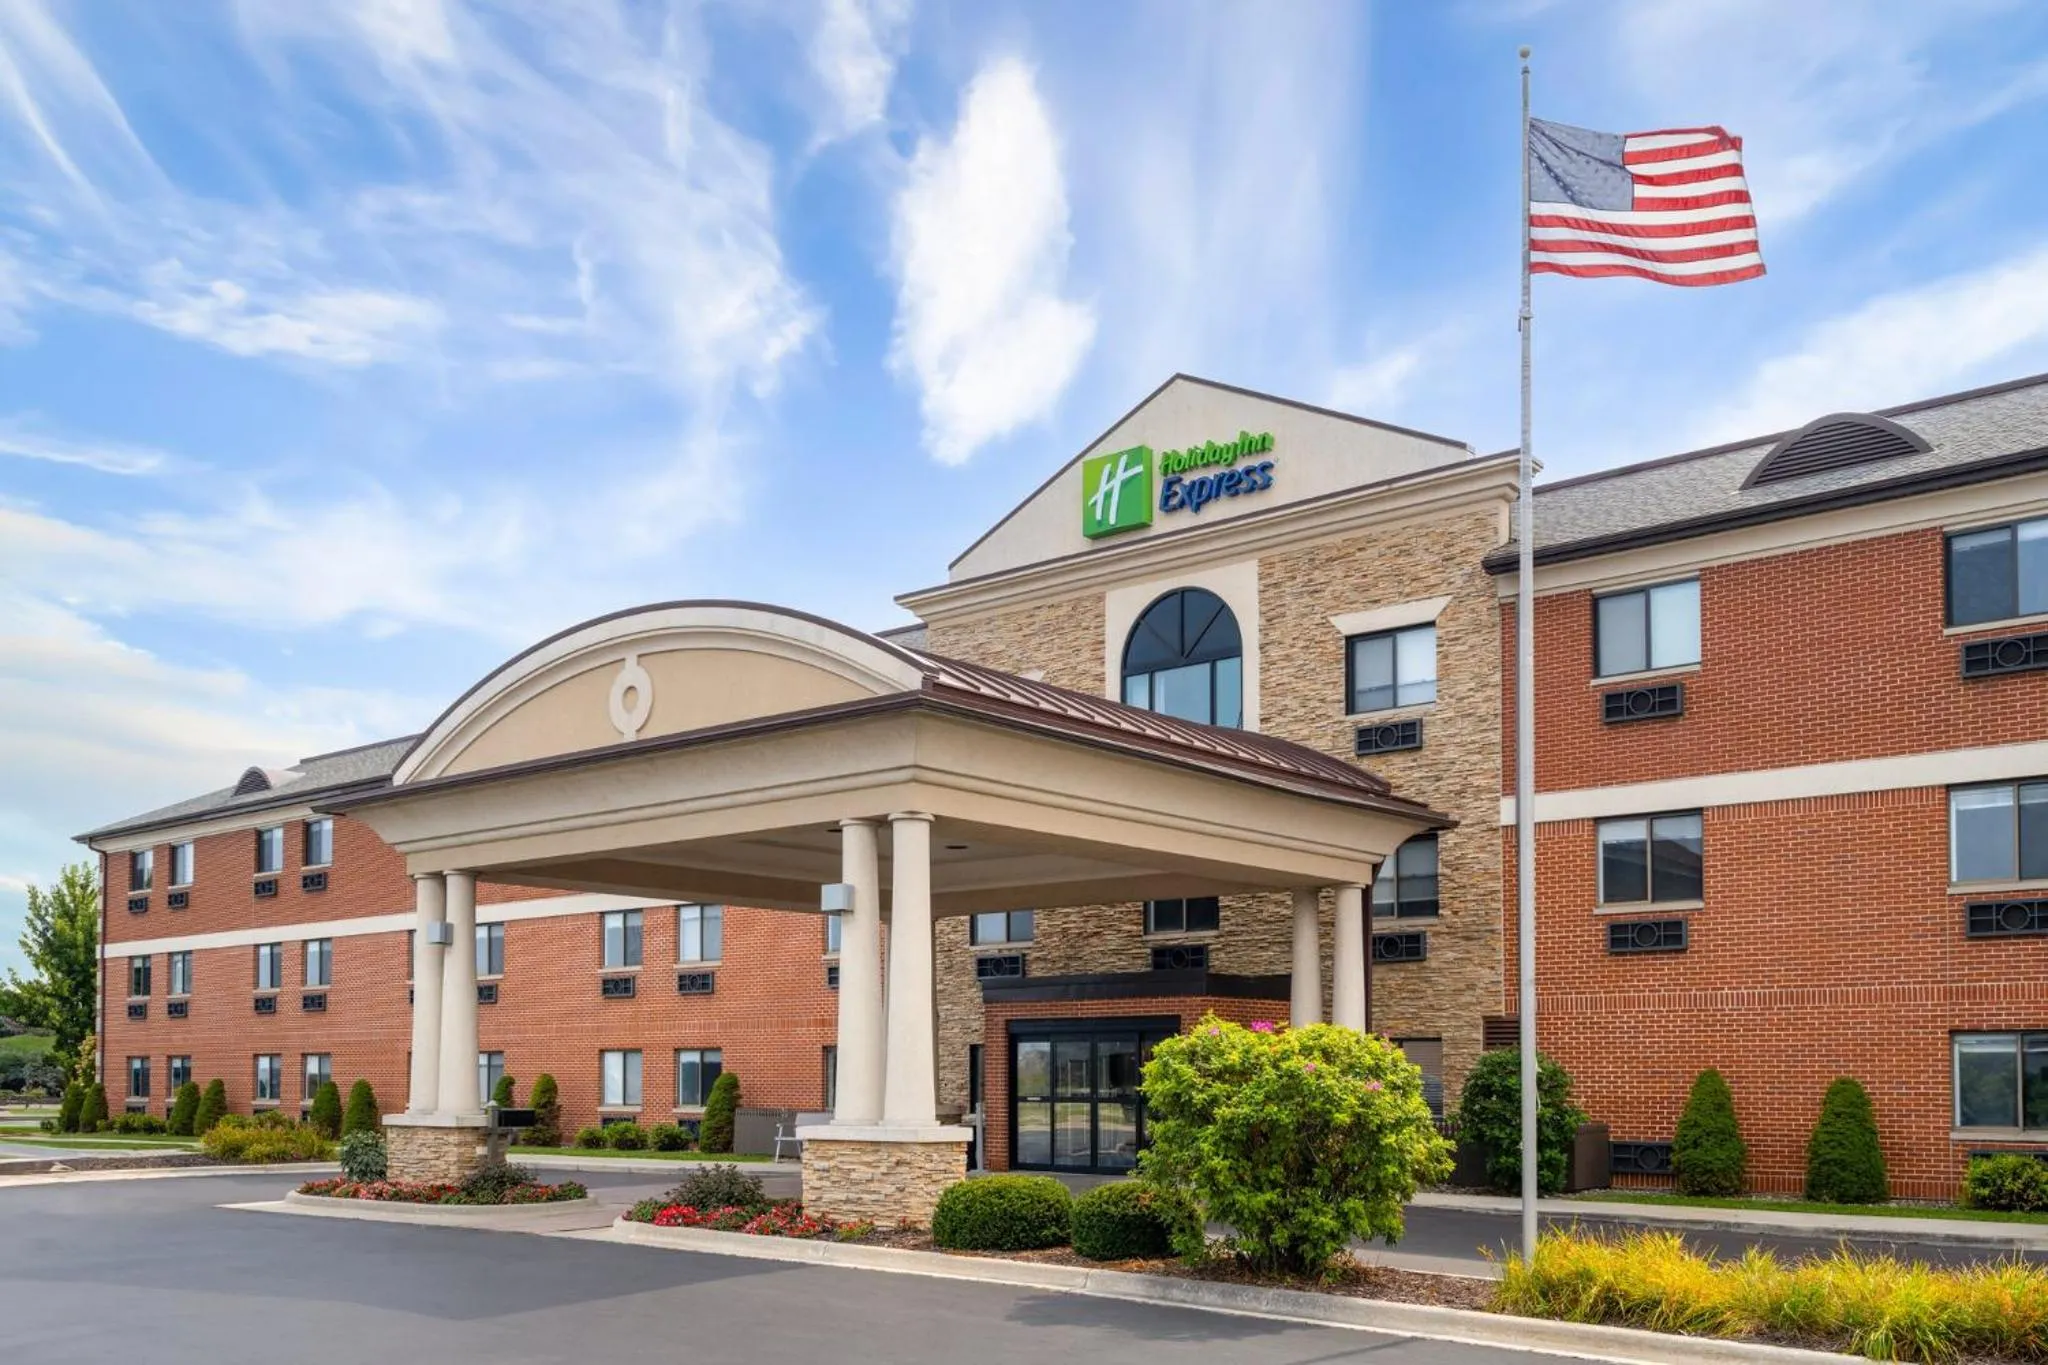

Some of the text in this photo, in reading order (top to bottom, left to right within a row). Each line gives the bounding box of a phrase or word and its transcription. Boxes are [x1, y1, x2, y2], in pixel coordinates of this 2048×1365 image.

[1160, 430, 1275, 476] Holiday Inn
[1159, 460, 1275, 514] Express
